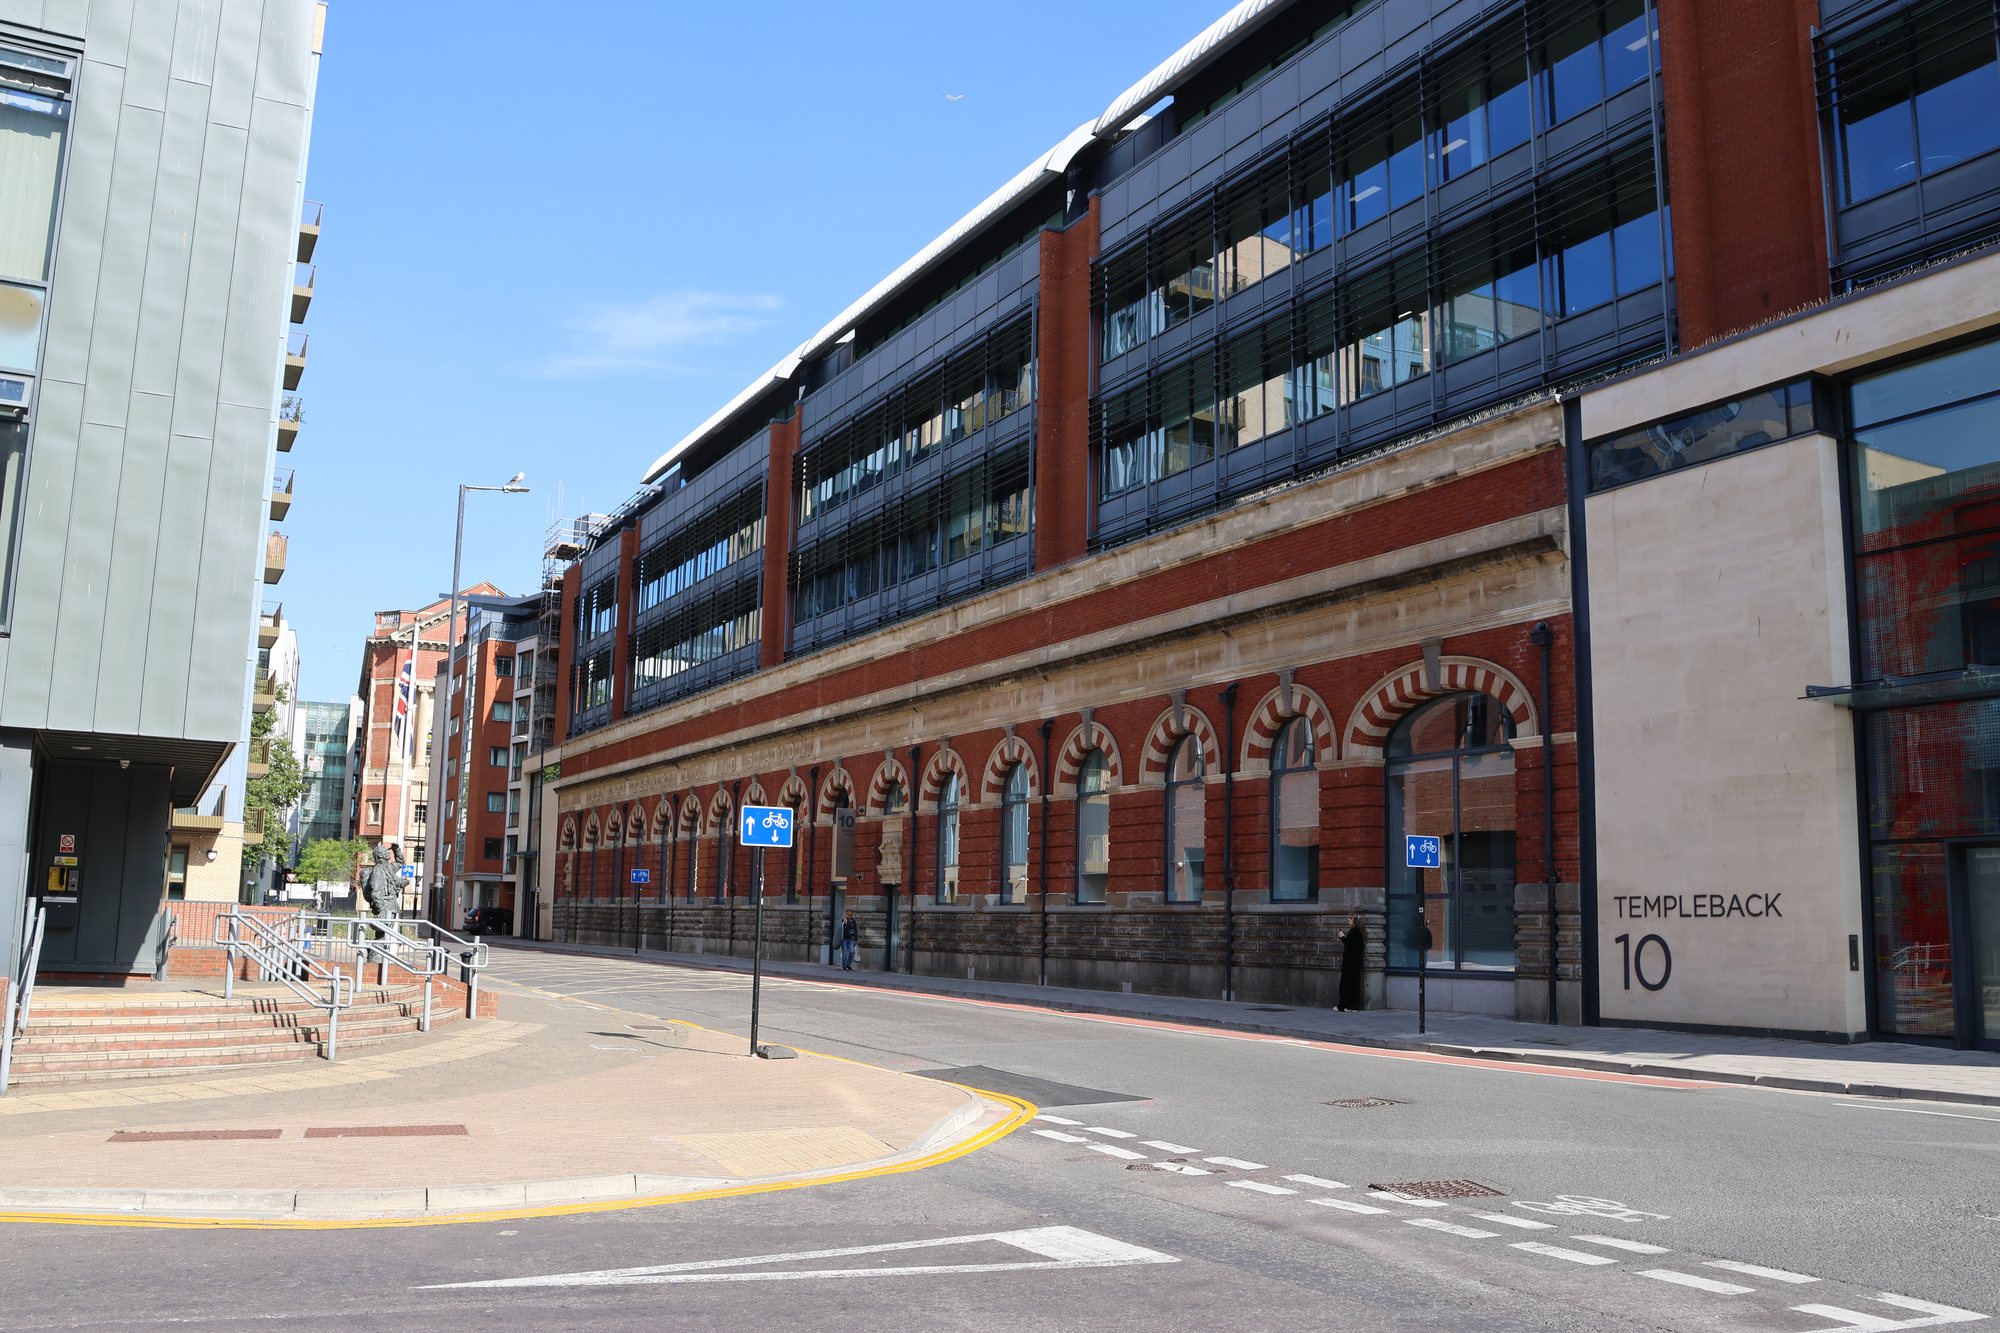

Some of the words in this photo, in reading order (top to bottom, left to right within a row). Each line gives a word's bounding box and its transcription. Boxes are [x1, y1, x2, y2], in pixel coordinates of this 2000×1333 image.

[684, 756, 737, 783] LIGHTING
[838, 815, 855, 828] 10
[1614, 893, 1783, 918] TEMPLEBACK
[1615, 934, 1673, 991] 10
